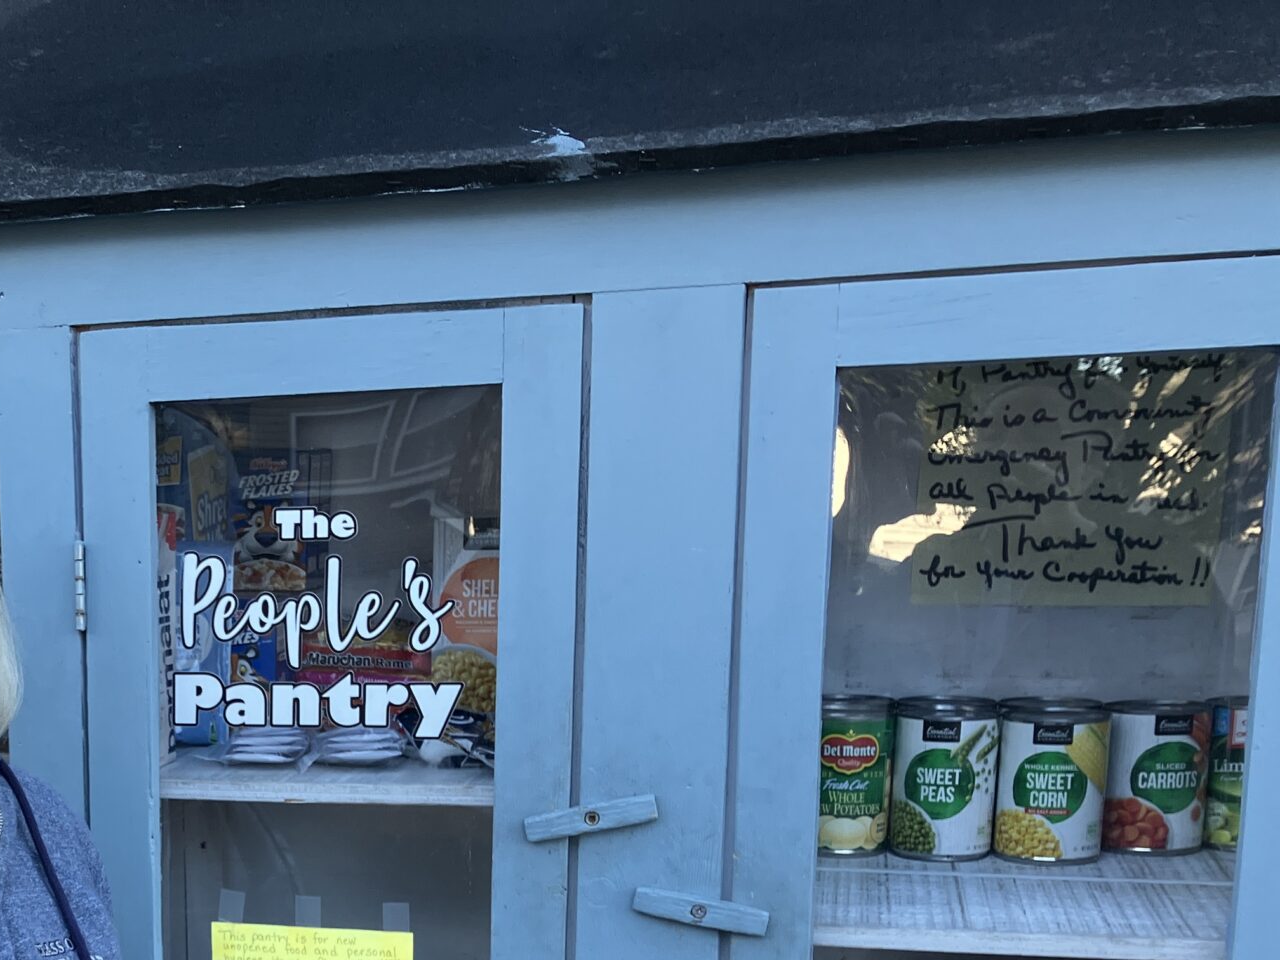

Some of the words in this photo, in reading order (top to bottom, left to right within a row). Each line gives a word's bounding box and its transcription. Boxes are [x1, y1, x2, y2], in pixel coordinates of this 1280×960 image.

[926, 402, 993, 430] This
[1003, 405, 1025, 427] is
[1032, 409, 1057, 423] a
[238, 469, 300, 489] FROSTED
[241, 482, 294, 500] FLAKES
[274, 508, 357, 540] The
[962, 514, 1096, 563] Thank
[919, 555, 966, 587] for
[462, 579, 498, 599] SHEL
[180, 551, 453, 669] People's
[307, 652, 371, 667] Maruchan
[173, 673, 464, 739] Pantry
[823, 745, 841, 757] Del
[842, 745, 876, 757] Monte
[1024, 763, 1049, 771] WHOLE
[1051, 763, 1079, 772] KERNEL
[1155, 763, 1187, 771] SLICED
[1214, 759, 1245, 773] Lim
[916, 767, 962, 786] SWEET
[1026, 772, 1074, 790] SWEET
[1138, 770, 1198, 789] CARROTS
[828, 791, 865, 803] WHOLE
[920, 785, 955, 804] PEAS
[1029, 791, 1068, 808] CORN
[833, 803, 881, 816] POTATOES
[218, 930, 246, 942] This
[252, 932, 289, 946] pantry
[296, 933, 307, 944] is
[313, 931, 329, 944] for
[336, 936, 357, 945] new
[223, 943, 277, 955] unopened
[285, 943, 308, 955] food
[314, 945, 338, 956] and
[346, 946, 397, 960] personal
